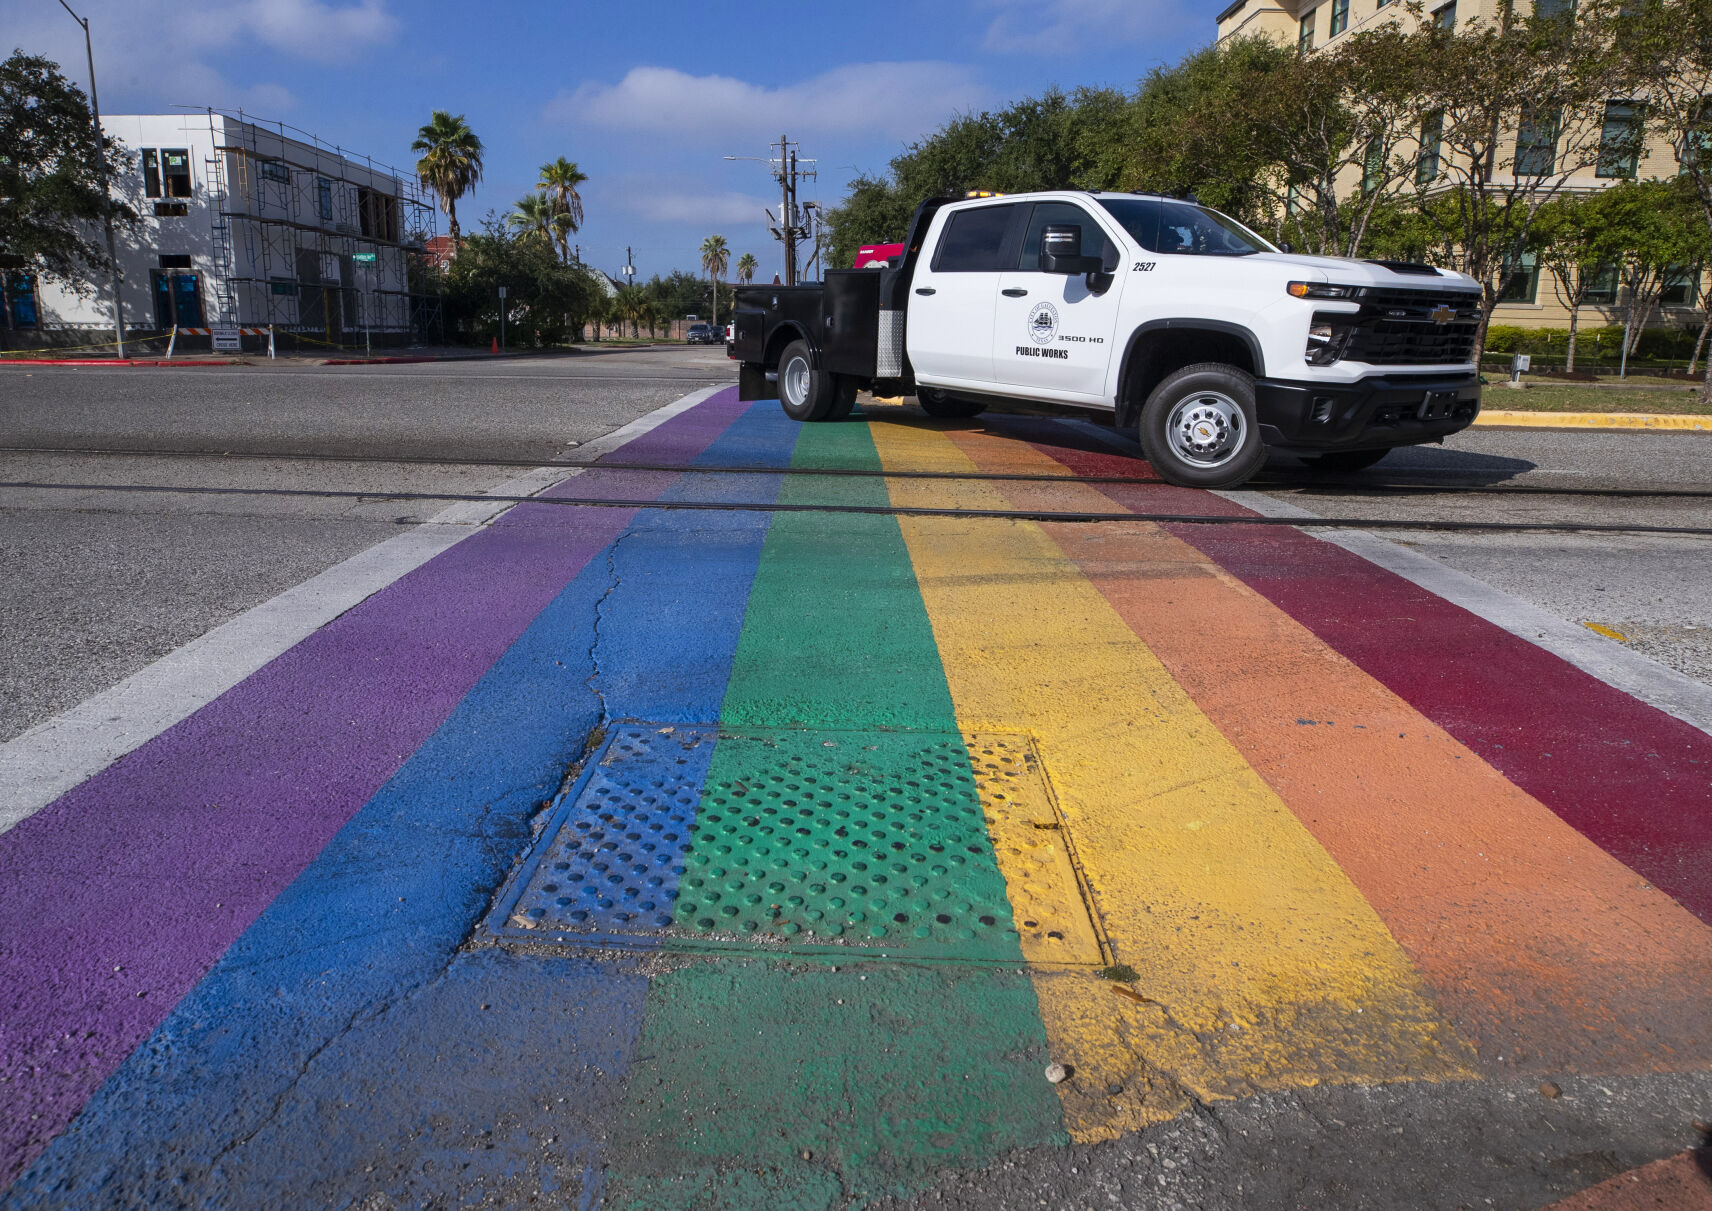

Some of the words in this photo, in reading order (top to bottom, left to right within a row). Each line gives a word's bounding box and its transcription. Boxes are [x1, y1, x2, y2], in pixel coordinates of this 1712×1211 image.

[1132, 262, 1157, 272] 2527
[1058, 335, 1086, 343] 3500
[1016, 346, 1040, 357] PUBLIC
[1041, 348, 1069, 360] WORKS
